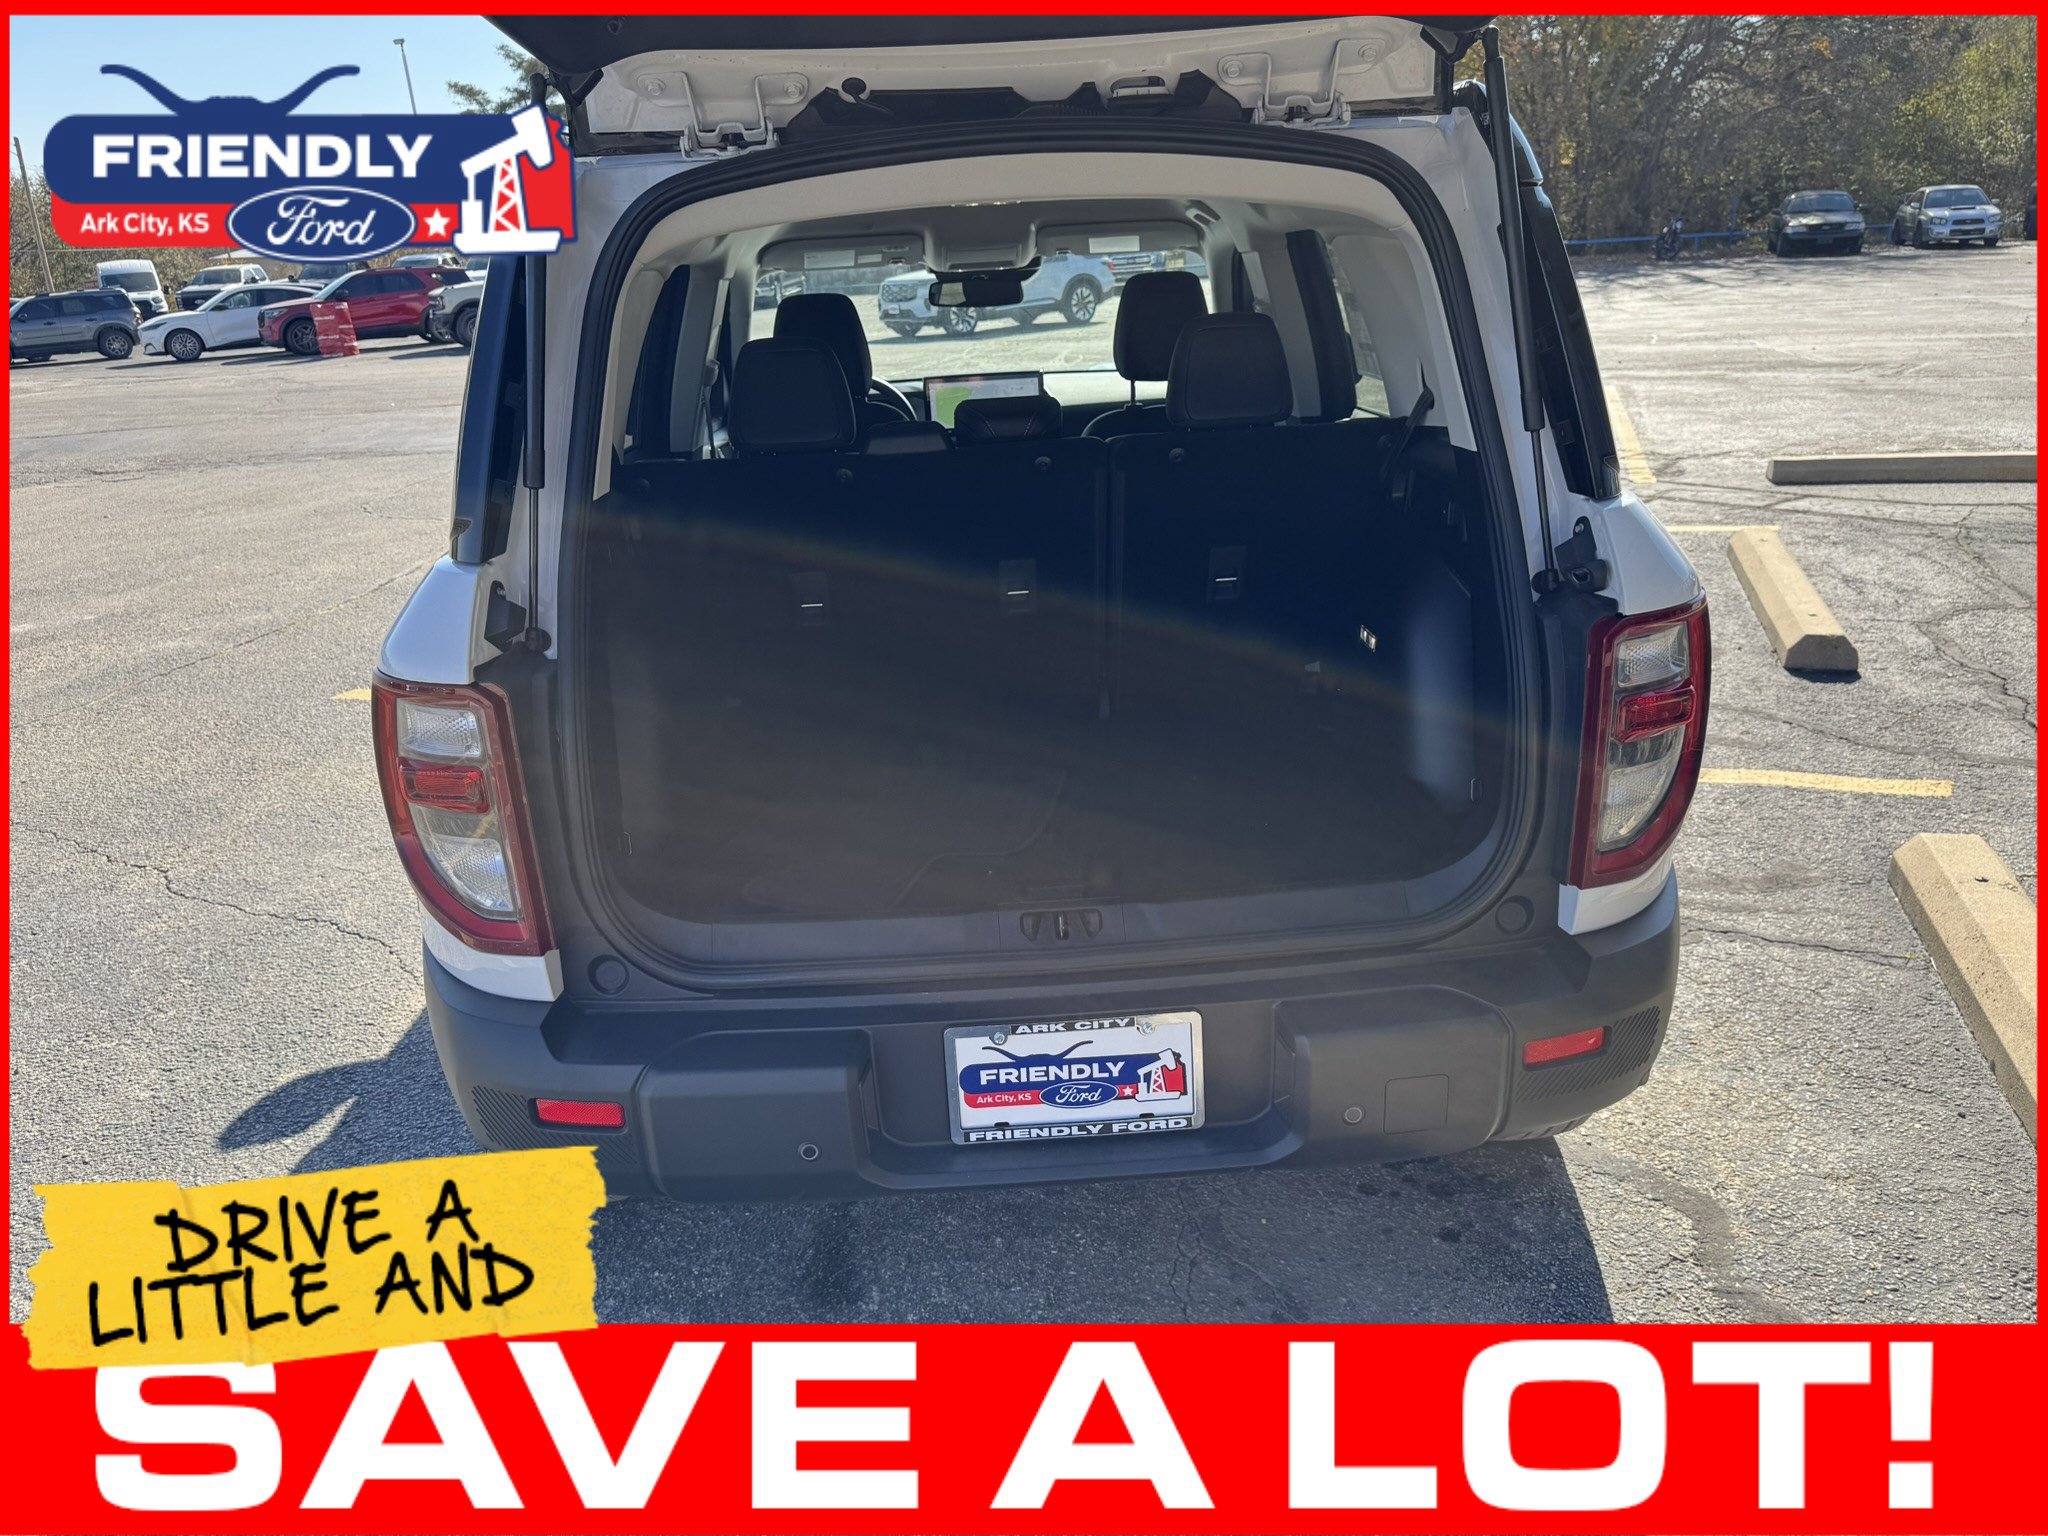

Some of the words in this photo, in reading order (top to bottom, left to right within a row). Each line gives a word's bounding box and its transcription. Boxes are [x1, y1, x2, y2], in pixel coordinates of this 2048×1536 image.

[1015, 1022, 1068, 1034] ARK
[1074, 1018, 1130, 1031] CITY
[980, 1061, 1126, 1085] FRIENDLY
[976, 1094, 994, 1104] Ark
[995, 1093, 1017, 1105] City,
[1018, 1092, 1032, 1102] KS
[1055, 1084, 1102, 1104] Ford
[969, 1124, 1104, 1142] FRIENDLY
[1112, 1118, 1188, 1134] FORD
